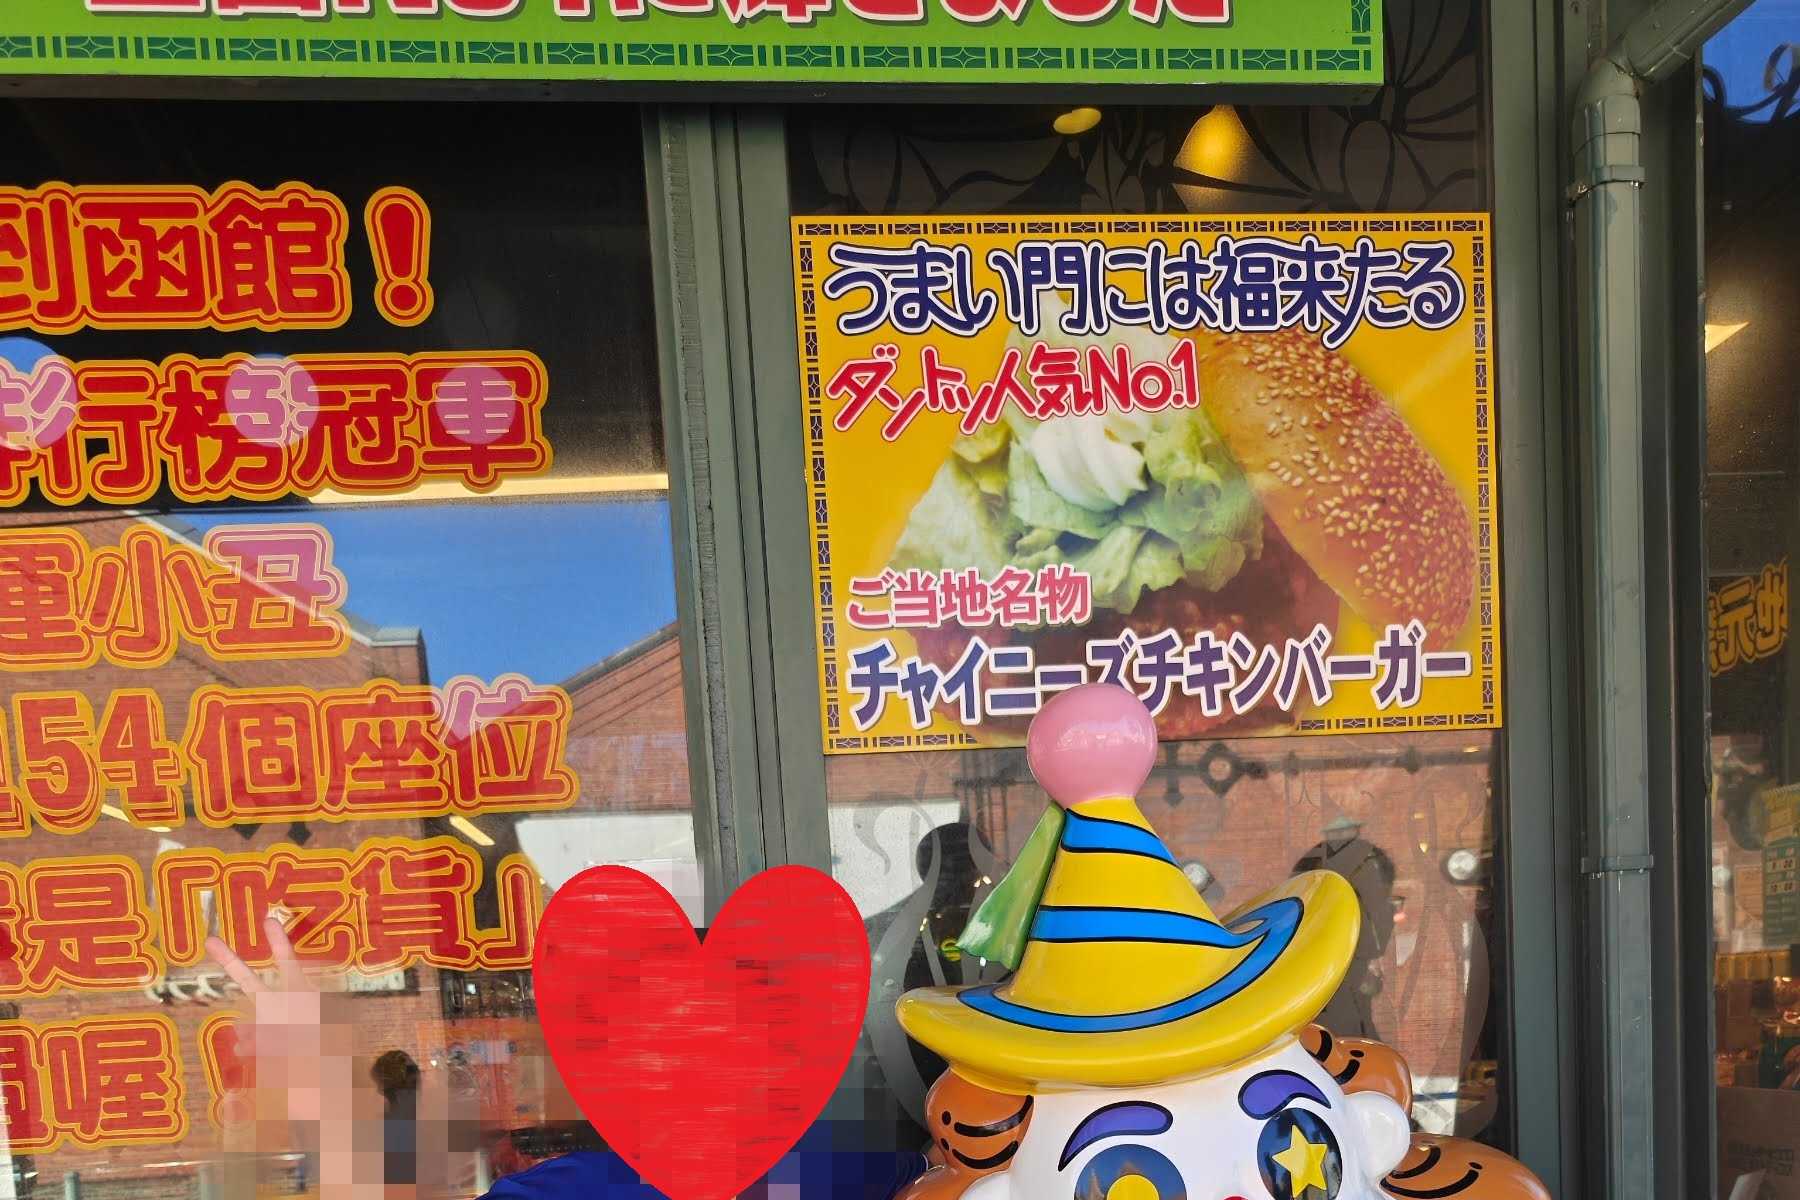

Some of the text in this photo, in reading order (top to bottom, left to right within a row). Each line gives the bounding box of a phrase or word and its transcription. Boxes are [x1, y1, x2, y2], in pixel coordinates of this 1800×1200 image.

[823, 236, 1465, 346] うまい門には福来たる
[0, 351, 553, 506] 行榜冠軍
[846, 564, 1091, 629] ご当地名物
[847, 621, 1472, 731] チャイニーズチキンバーガー
[0, 674, 580, 838] 54個座位
[0, 838, 543, 998] 是「吃貨」
